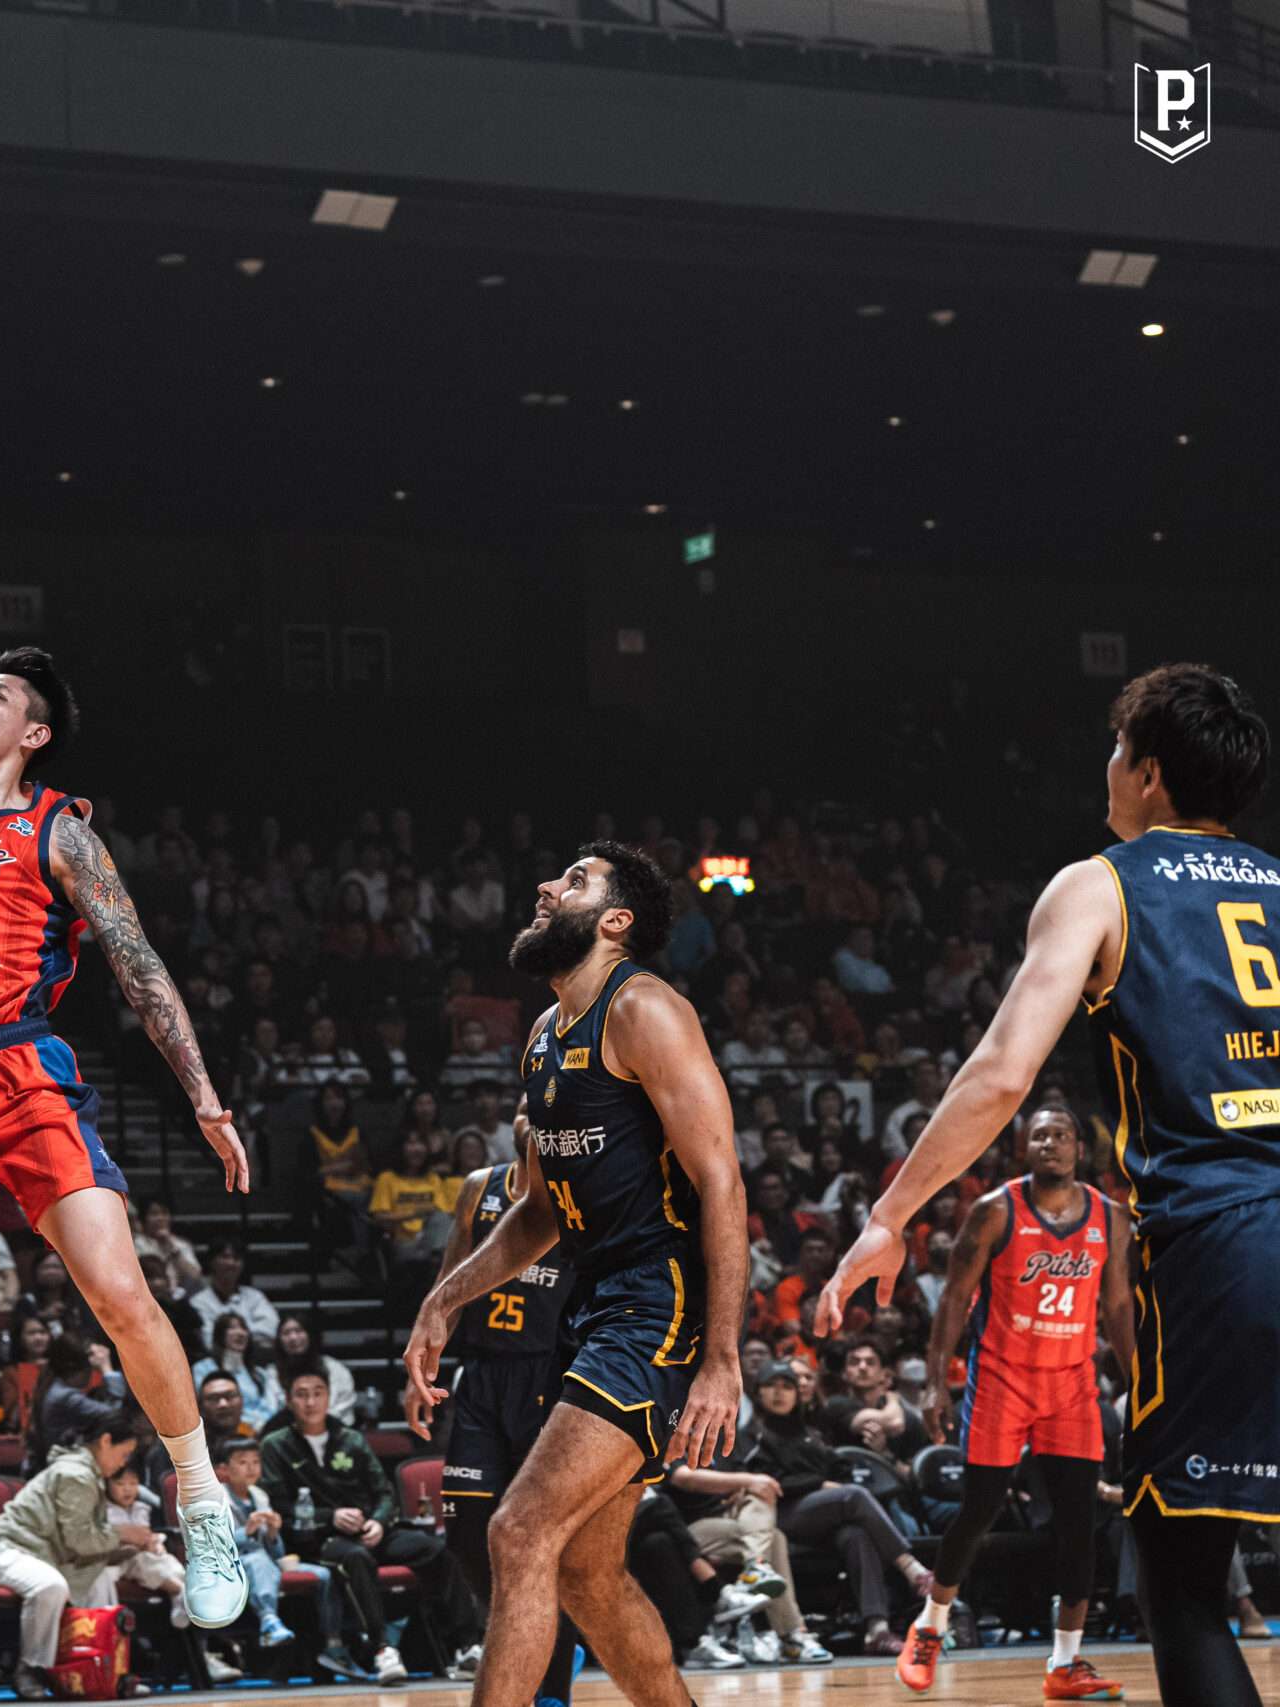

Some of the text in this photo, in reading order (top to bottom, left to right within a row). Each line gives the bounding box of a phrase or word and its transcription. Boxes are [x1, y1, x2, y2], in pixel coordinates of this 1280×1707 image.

[1186, 863, 1280, 886] NICIGAS
[1216, 901, 1280, 1008] 6
[1018, 1248, 1099, 1286] Pilots
[487, 1292, 526, 1332] 25
[1038, 1283, 1075, 1317] 24
